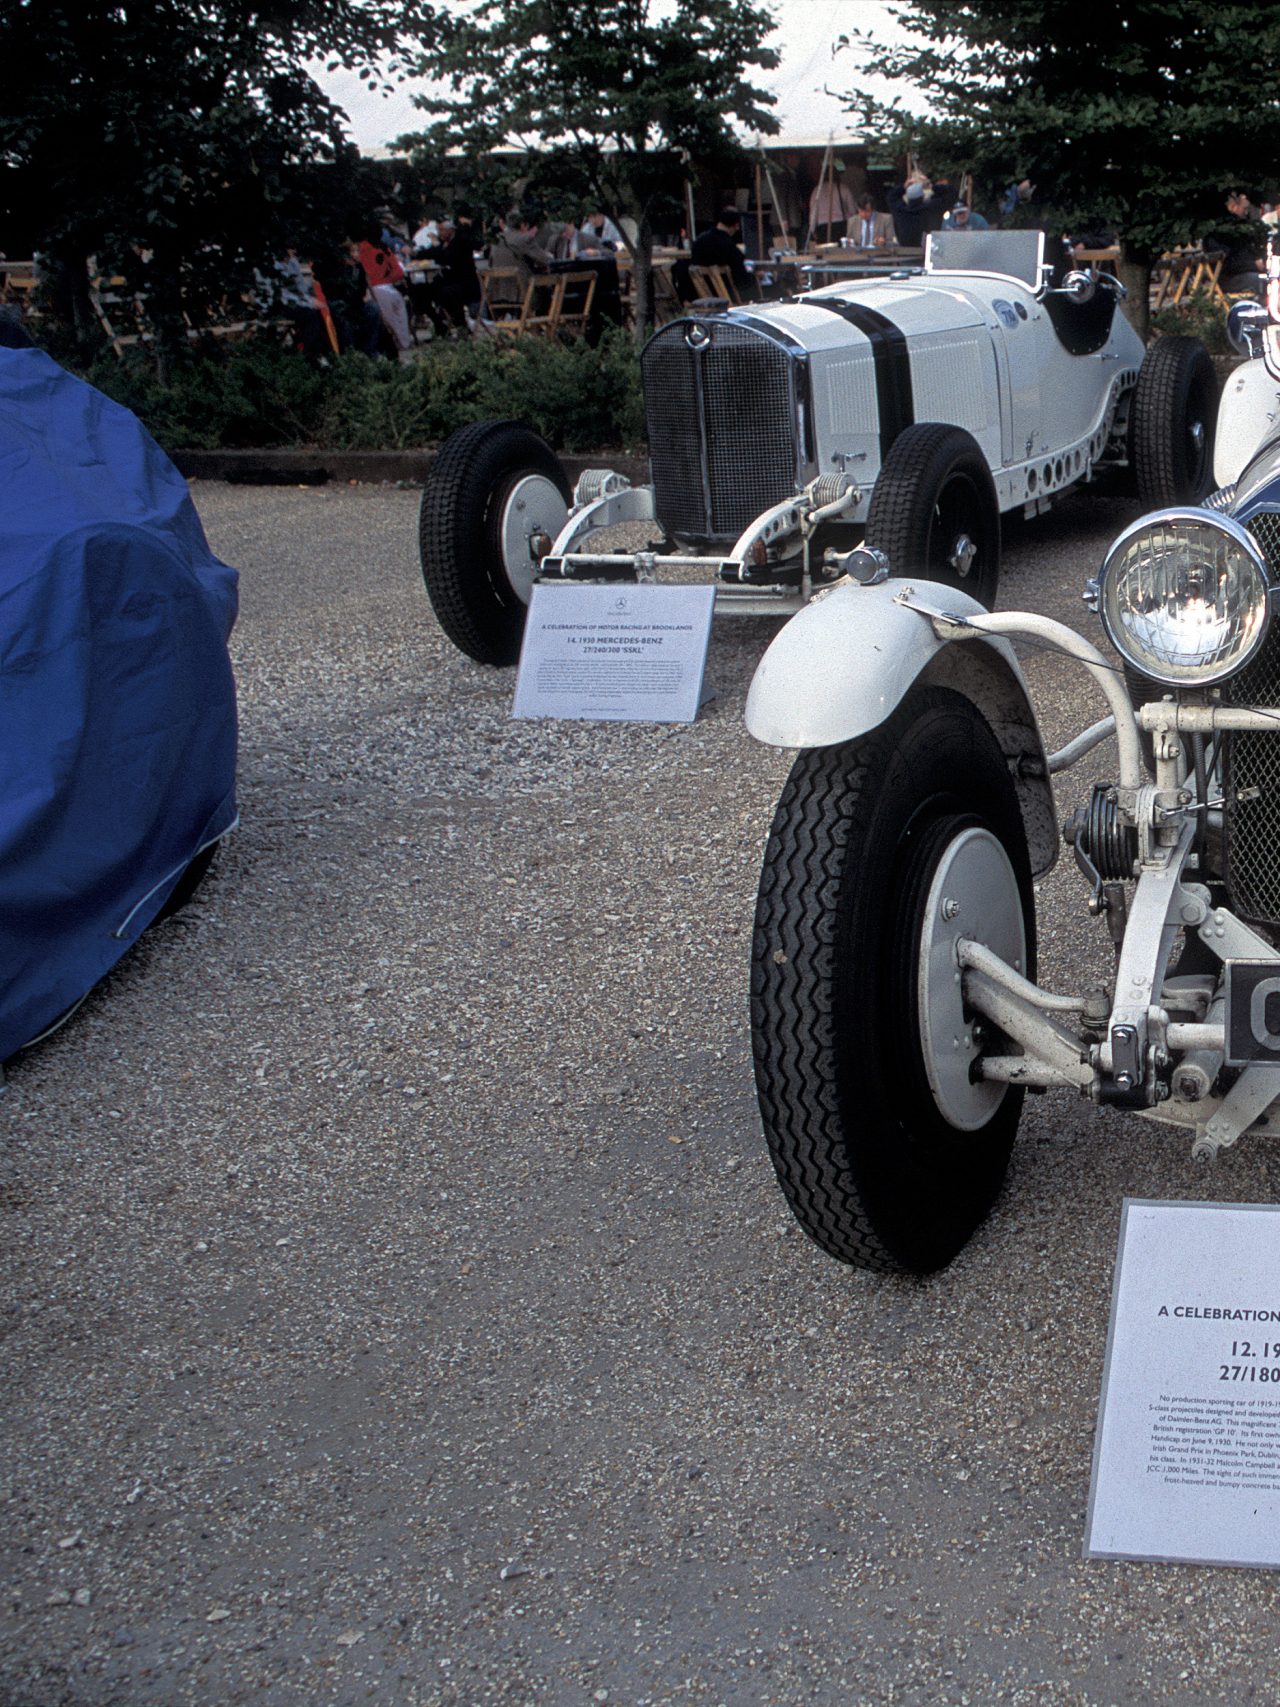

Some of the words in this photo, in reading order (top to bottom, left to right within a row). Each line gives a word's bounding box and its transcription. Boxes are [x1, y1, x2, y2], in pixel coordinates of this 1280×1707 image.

[596, 637, 664, 645] MERCEDES-BENZ
[1158, 1305, 1170, 1317] A
[1231, 1341, 1256, 1357] 12.
[1159, 1394, 1170, 1402] No
[1171, 1395, 1207, 1405] production
[1208, 1397, 1235, 1407] sporting
[1148, 1404, 1170, 1412] S-class
[1170, 1405, 1204, 1415] projectiles
[1205, 1407, 1234, 1417] designed
[1234, 1408, 1247, 1416] and
[1248, 1409, 1280, 1419] developed
[1167, 1415, 1210, 1424] Daimler-Benz
[1226, 1418, 1239, 1426] This
[1152, 1424, 1174, 1432] British
[1175, 1425, 1212, 1436] registration
[1250, 1429, 1264, 1437] first
[1191, 1436, 1206, 1445] June
[1246, 1439, 1258, 1447] not
[1259, 1440, 1274, 1449] only
[1152, 1444, 1167, 1452] Irish
[1168, 1445, 1189, 1453] Grand
[1212, 1448, 1239, 1456] Phoenix
